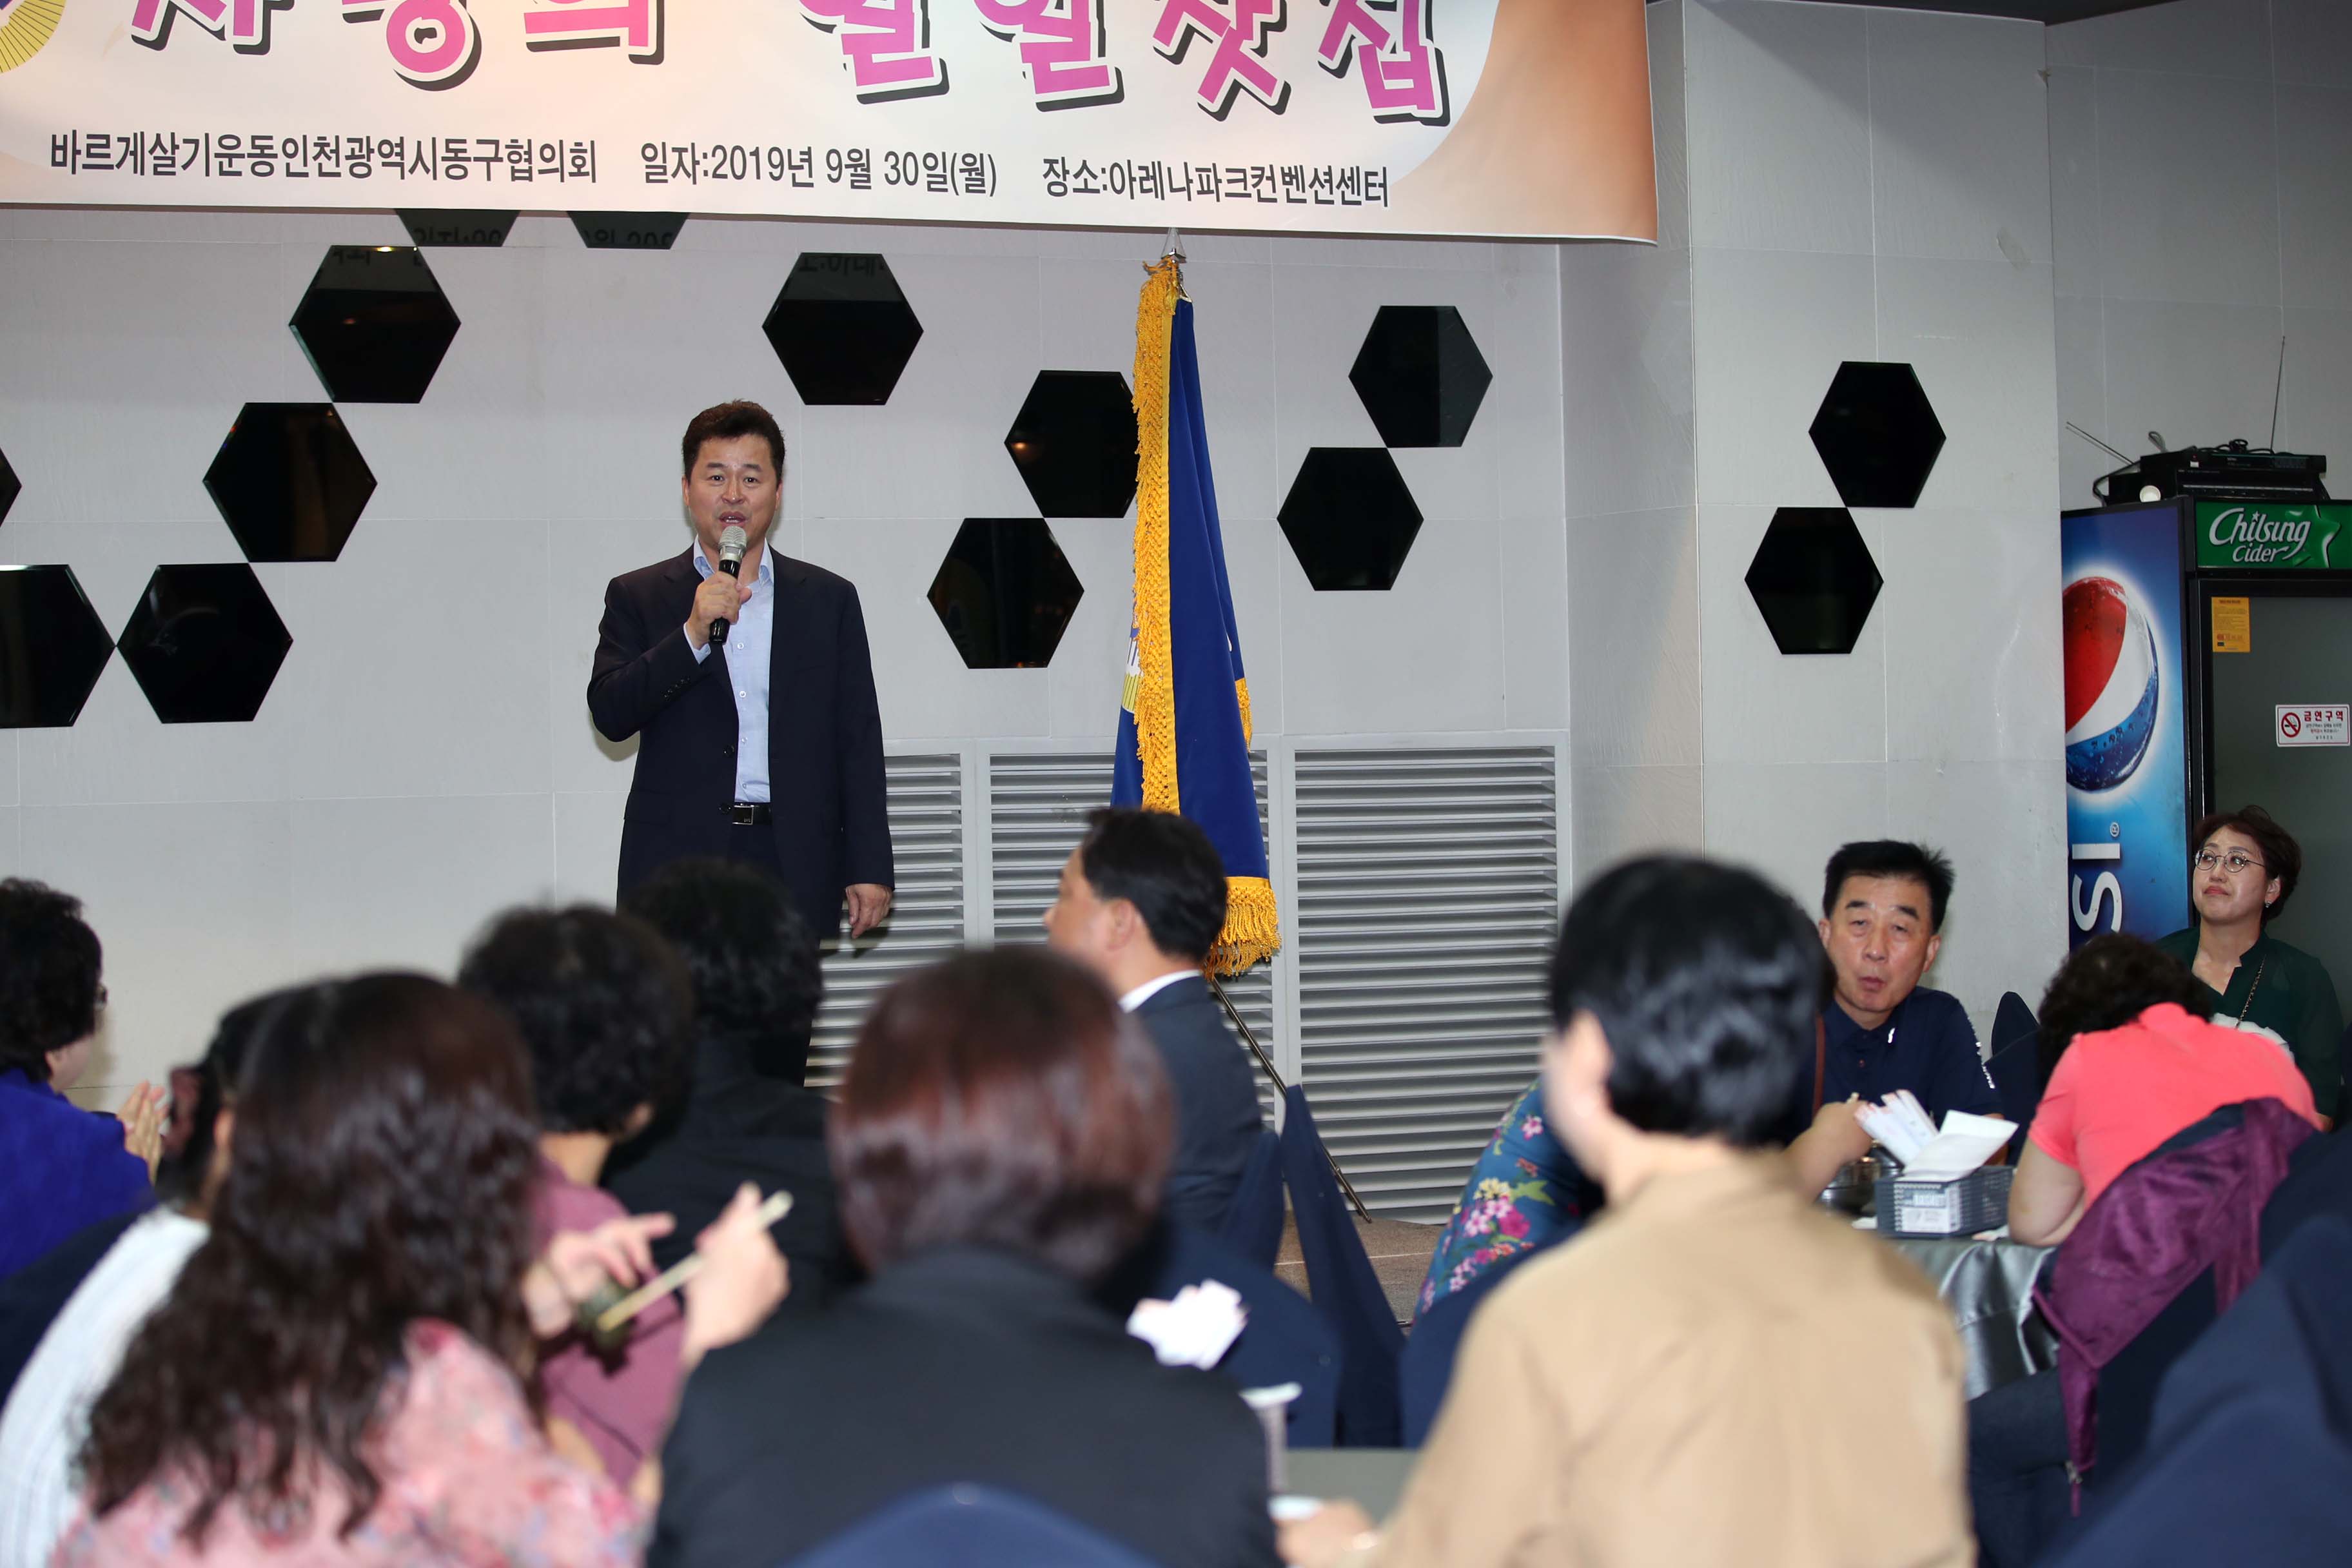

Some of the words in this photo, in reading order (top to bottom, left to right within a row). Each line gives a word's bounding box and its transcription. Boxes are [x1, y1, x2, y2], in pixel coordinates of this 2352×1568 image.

[51, 129, 596, 183] 바르게살기운동인천광역시동구협의회
[641, 142, 814, 188] 일자:2019년
[826, 148, 872, 190] 9월
[884, 151, 996, 197] 30일(월)
[1043, 156, 1388, 208] 장소:아레나파크컨벤션센터
[2209, 507, 2311, 560] Chilsung
[2304, 710, 2344, 721] 금연구역
